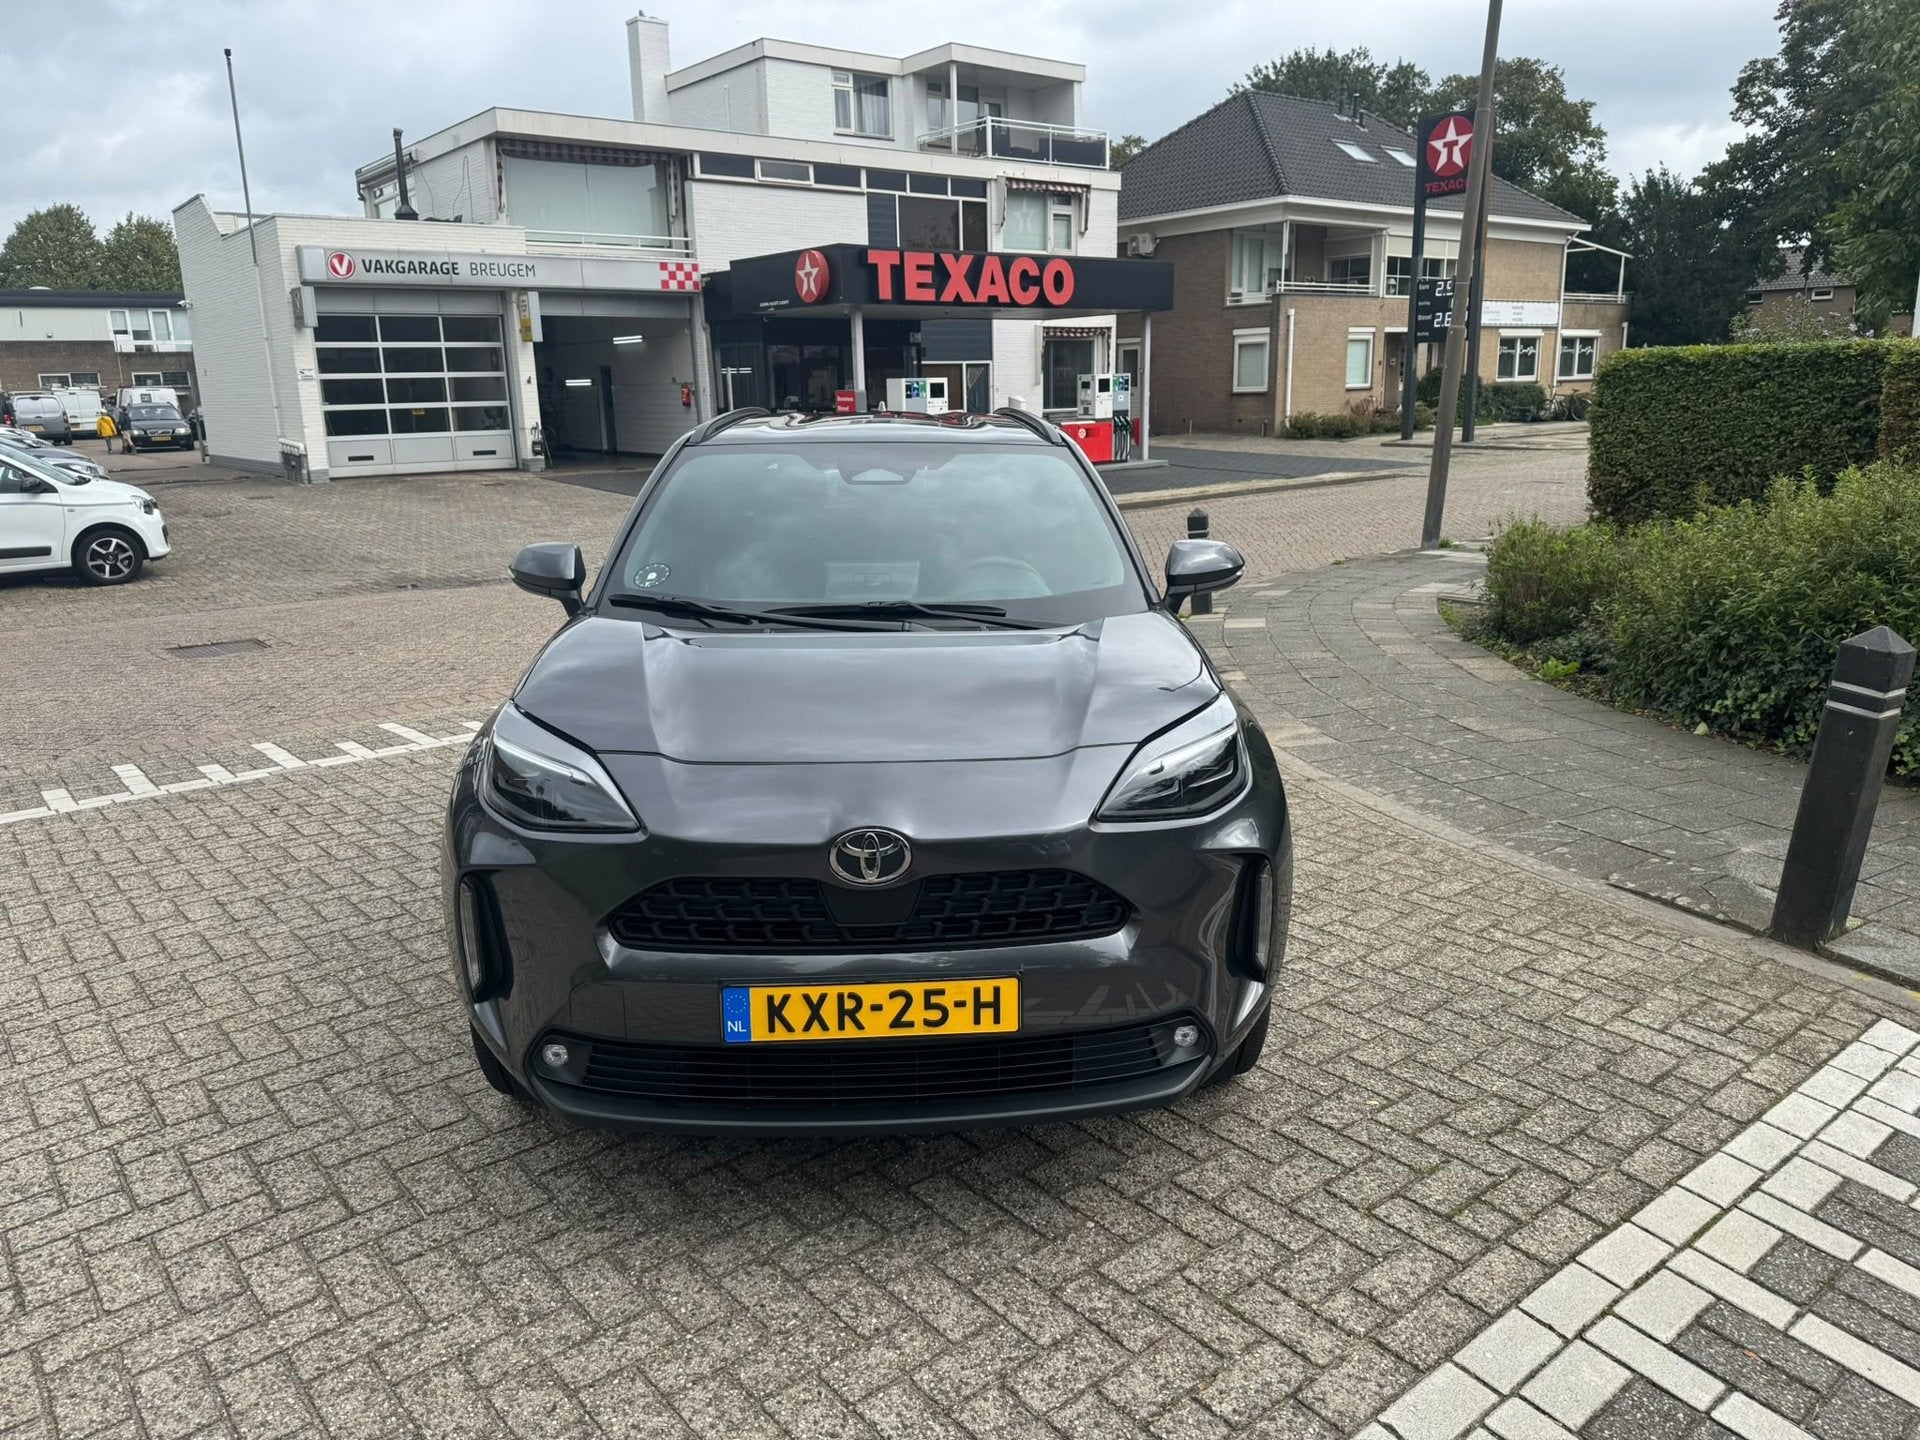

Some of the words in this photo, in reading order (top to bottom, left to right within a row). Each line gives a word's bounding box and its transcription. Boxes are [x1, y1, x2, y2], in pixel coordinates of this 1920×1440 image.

[1425, 179, 1467, 194] TEXAC
[361, 258, 460, 276] VAKGARAGE
[469, 262, 536, 278] BREUGEM
[867, 249, 1074, 306] TEXACO
[727, 1020, 747, 1034] NL
[766, 985, 1001, 1034] KXR-25-H
